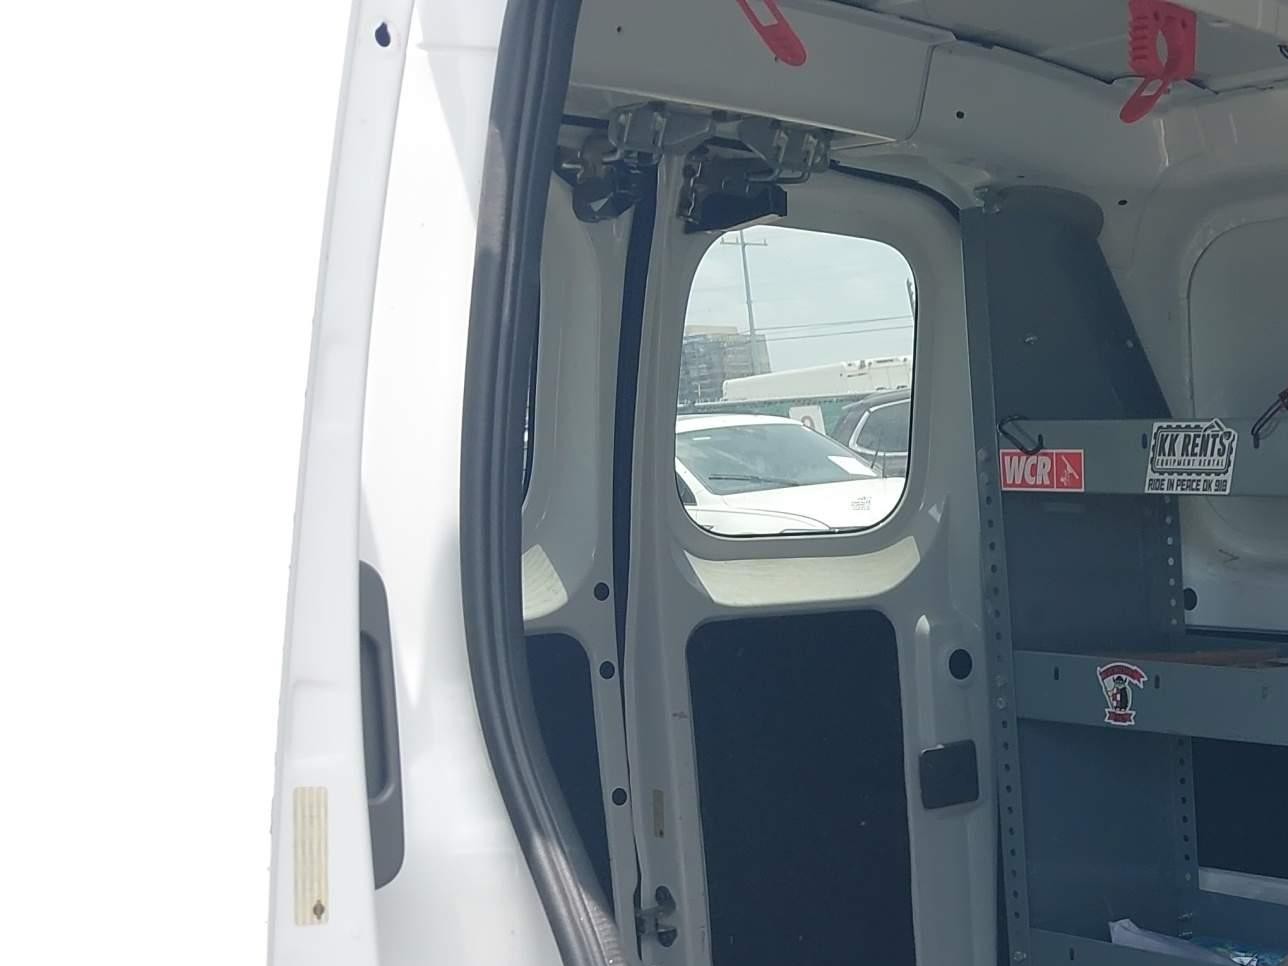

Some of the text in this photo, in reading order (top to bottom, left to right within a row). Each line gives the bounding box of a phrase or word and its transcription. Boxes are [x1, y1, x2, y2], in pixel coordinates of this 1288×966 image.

[1158, 433, 1226, 457] KK RENTS
[1004, 455, 1052, 485] WCR
[1147, 478, 1166, 491] RIDE
[1166, 478, 1175, 491] IN
[1175, 478, 1201, 492] PEACE
